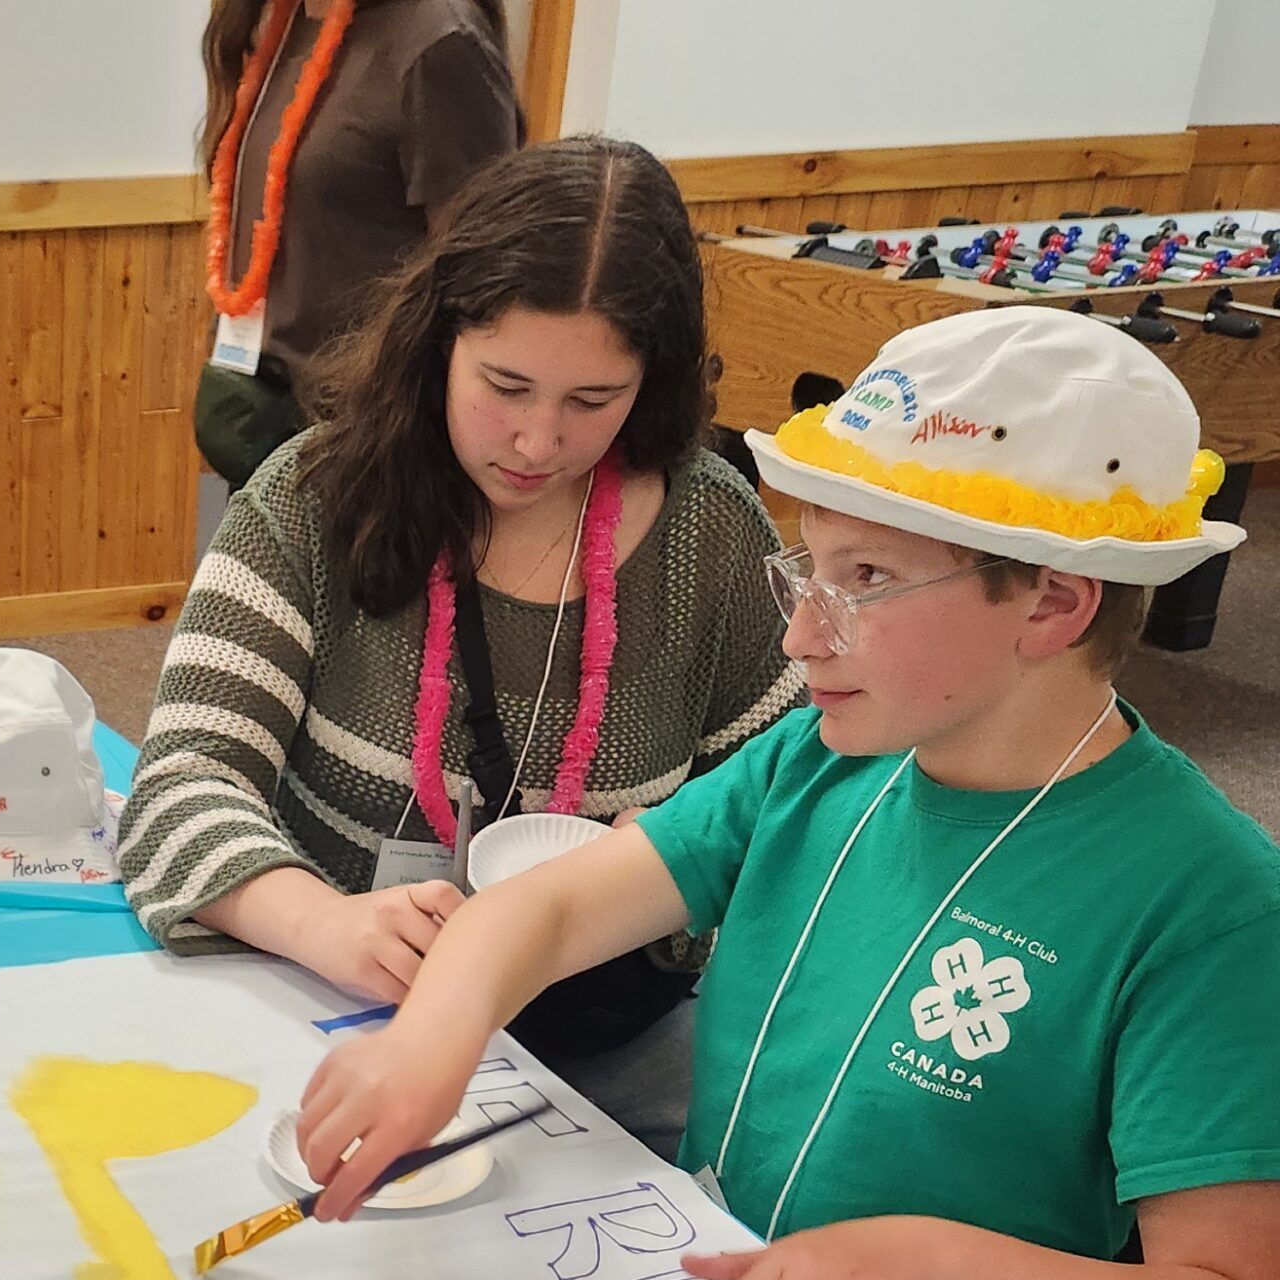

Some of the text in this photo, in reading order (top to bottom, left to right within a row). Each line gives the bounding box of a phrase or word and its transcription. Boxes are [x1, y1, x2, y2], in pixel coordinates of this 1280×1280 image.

[854, 388, 895, 412] CAMP
[12, 853, 70, 878] Kendra
[951, 906, 1059, 965] Balmoral 4-H Club
[887, 1061, 973, 1102] 4-H Manitoba
[891, 1041, 984, 1090] CANADA
